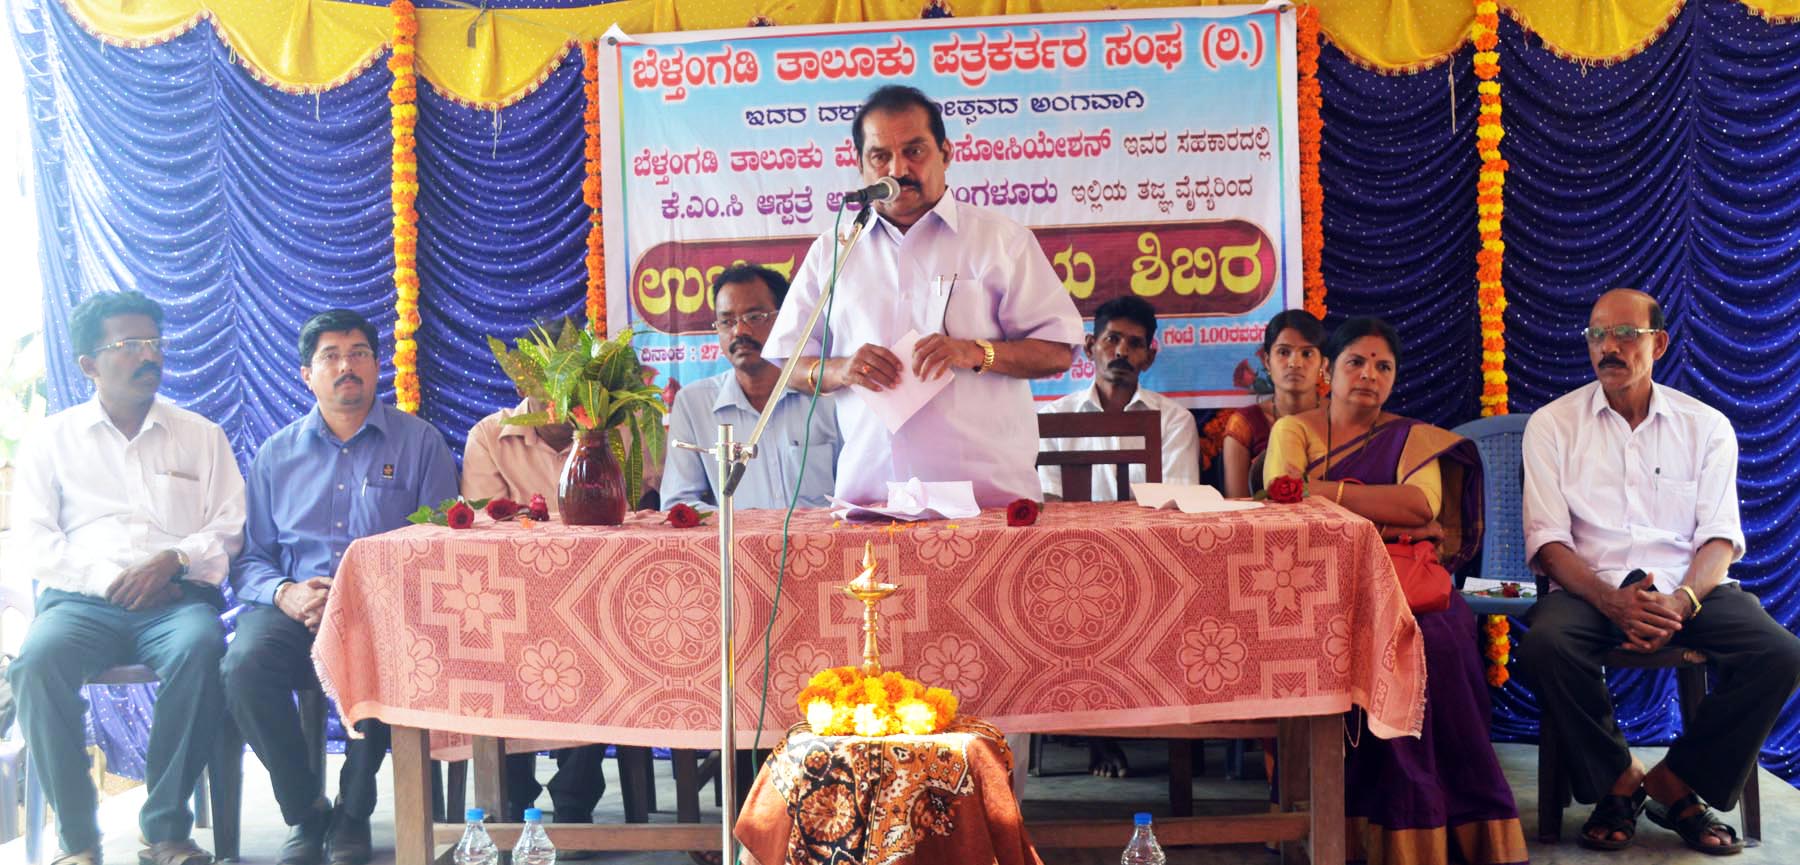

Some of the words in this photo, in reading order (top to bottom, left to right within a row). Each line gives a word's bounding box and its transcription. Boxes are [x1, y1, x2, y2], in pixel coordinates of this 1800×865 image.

[633, 47, 758, 101] ಬೆಳ್ತಂಗಡಿ
[776, 36, 915, 81] ತಾಲೂಕು
[932, 27, 1088, 87] ಪತ್ರಕರ್ತರ
[1105, 23, 1183, 71] ಸಂಘ
[1202, 22, 1265, 70] (ರಿ.)
[745, 107, 807, 126] ಇದರ
[1030, 89, 1145, 113] ಅಂಗವಾಗಿ
[633, 147, 718, 185] ಬೆಳ್ತಂಗಡಿ
[730, 140, 823, 173] ತಾಲೂಕು
[946, 127, 1111, 163] ಸೋಸಿಯೇಶನ್
[1123, 131, 1168, 158] ಇವರ
[1177, 126, 1271, 160] ಸಹಕಾರದಲ್ಲಿ
[757, 187, 813, 223] ಆಸ್ಪತ್ರೆ
[950, 177, 1058, 207] ಂಗಳೂರು
[1071, 179, 1127, 214] ಇಲ್ಲಿಯ
[1130, 231, 1262, 298] ಶಿಬಿರ
[641, 346, 685, 362] ದಿನಾಂಕ
